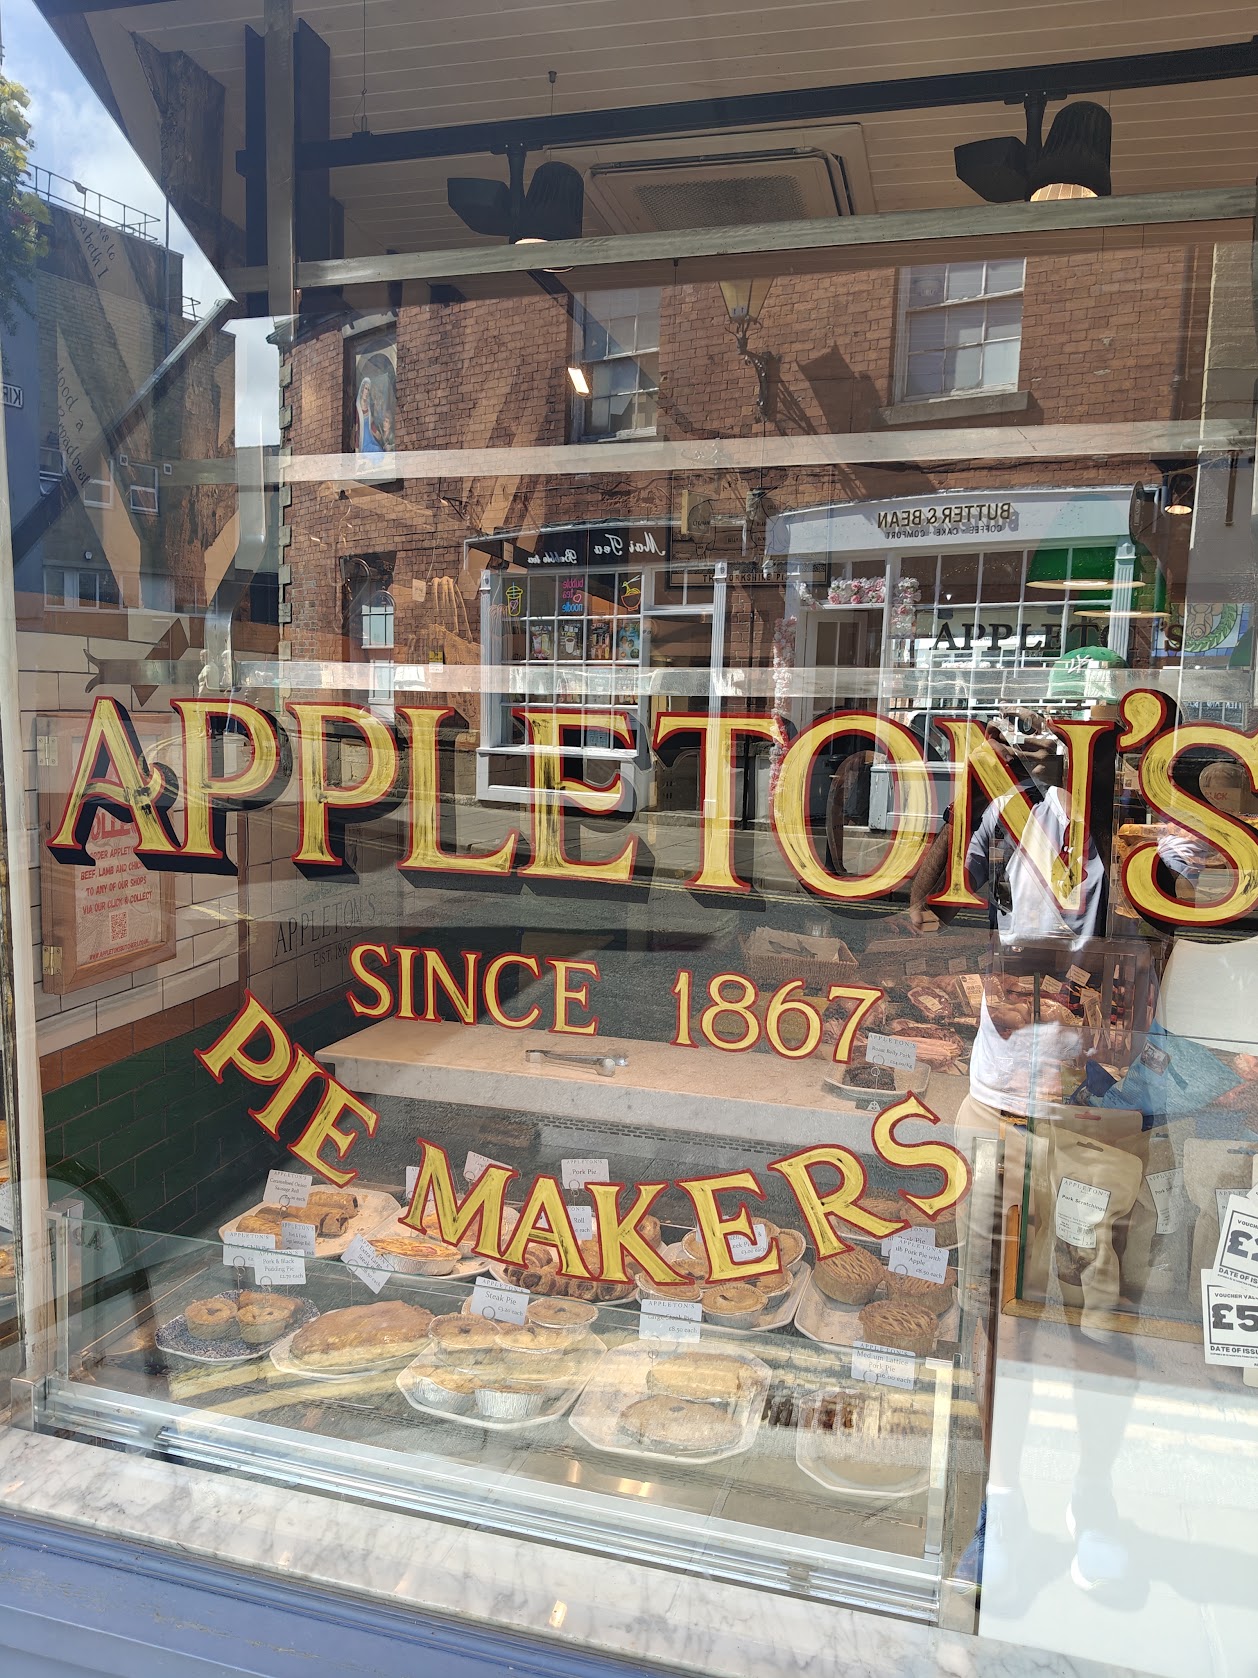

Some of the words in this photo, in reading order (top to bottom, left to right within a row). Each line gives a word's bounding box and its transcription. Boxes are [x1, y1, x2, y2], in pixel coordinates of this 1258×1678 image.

[727, 573, 772, 582] ORKSHIRE
[929, 620, 1183, 652] APPLETN'S
[47, 689, 1258, 927] APPLETON'S
[99, 867, 114, 879] LAMB
[115, 864, 127, 875] AND
[86, 887, 94, 897] TO
[95, 884, 108, 895] ANY
[108, 882, 117, 892] OF
[117, 879, 129, 890] OUR
[130, 875, 147, 887] SHOPS
[346, 942, 600, 1037] SINCE
[670, 968, 885, 1065] 1867
[194, 990, 379, 1188] PIE
[397, 1091, 972, 1287] MAKERS
[904, 1248, 918, 1256] Pork
[928, 1254, 941, 1262] with
[908, 1257, 926, 1266] Apple
[1218, 1267, 1239, 1278] DATE
[485, 1291, 504, 1302] Steak
[506, 1296, 517, 1305] Pie
[648, 1301, 695, 1309] APPLETON'S
[1210, 1345, 1231, 1353] DATE
[868, 1361, 884, 1370] Pork
[885, 1364, 896, 1372] Pie
[885, 1356, 909, 1366] Lattice
